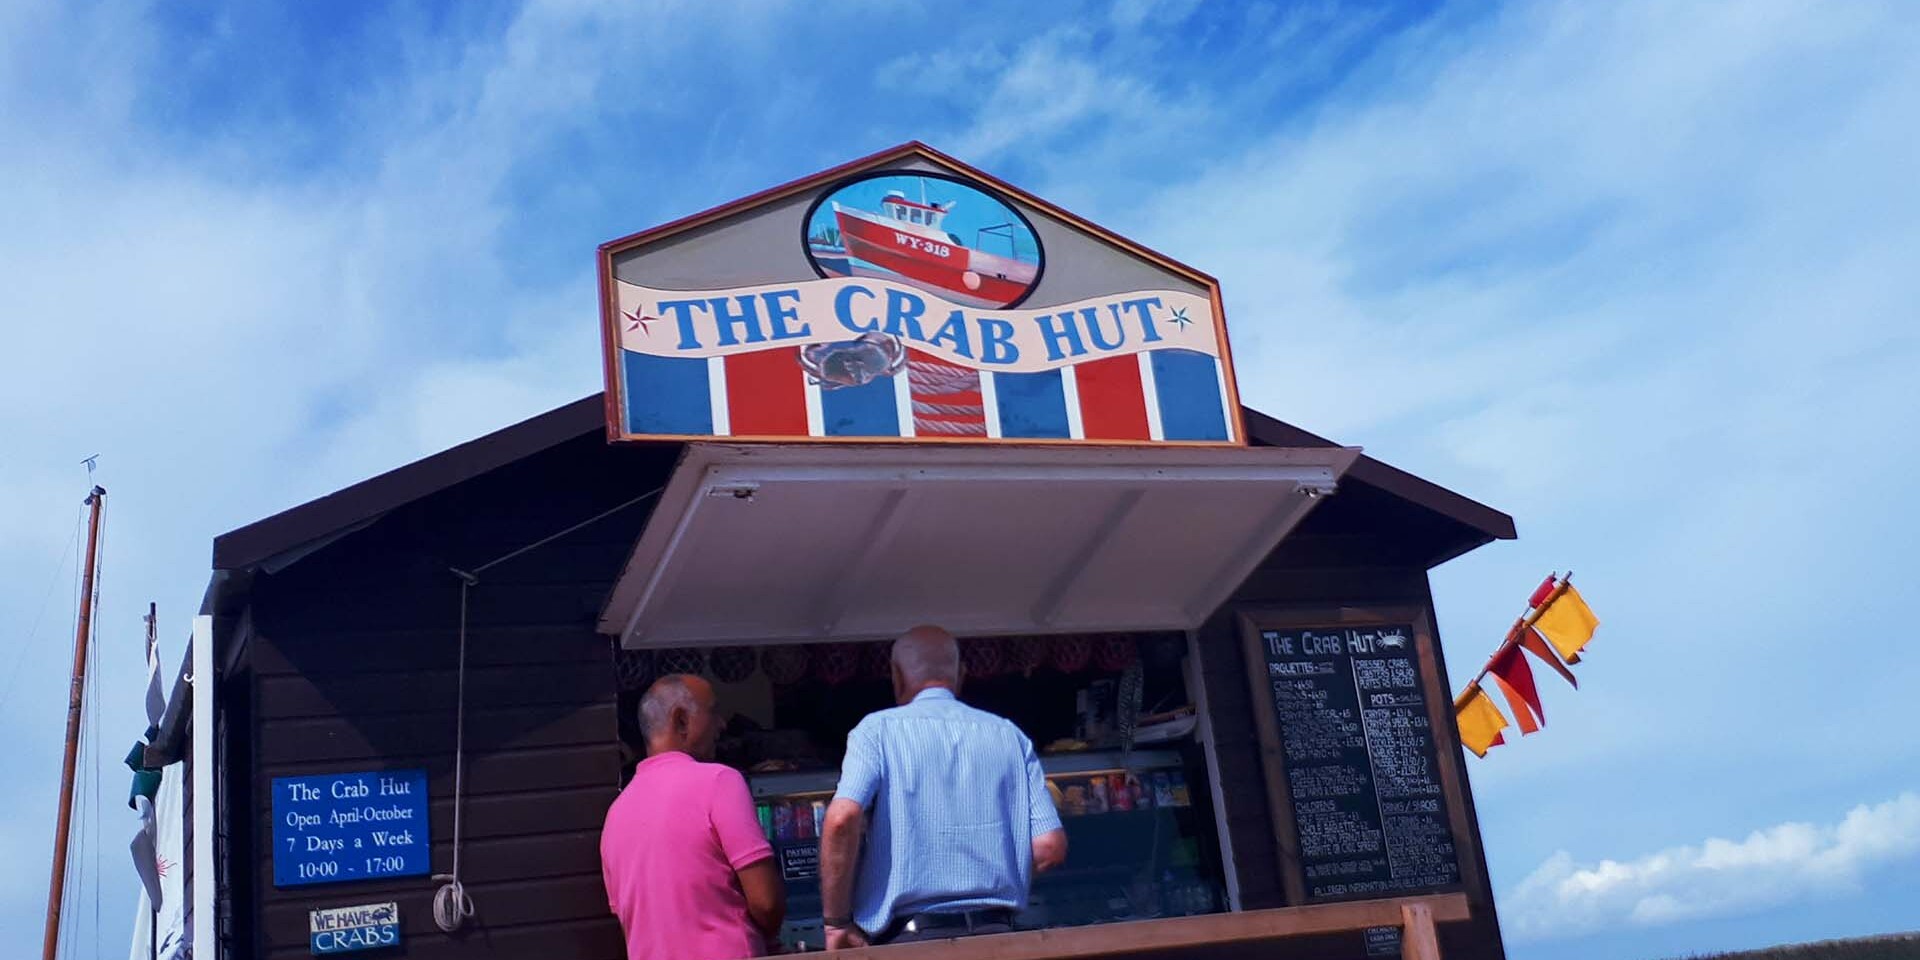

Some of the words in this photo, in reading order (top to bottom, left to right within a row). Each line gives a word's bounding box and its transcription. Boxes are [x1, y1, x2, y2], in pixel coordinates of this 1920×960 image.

[895, 232, 950, 258] WY-318
[658, 289, 811, 349] THE
[834, 285, 1020, 365] CRAB
[1034, 297, 1166, 362] HUT
[1263, 631, 1294, 655] THE
[1302, 631, 1342, 655] CRAB
[1345, 629, 1375, 653] HUT
[1269, 661, 1314, 674] BAGUETTES
[1370, 693, 1396, 705] POTS
[288, 783, 321, 801] The
[331, 780, 369, 798] Crab
[380, 777, 411, 796] Hut
[286, 812, 321, 831] Open
[328, 804, 413, 828] April-October
[286, 837, 296, 852] 7
[307, 835, 344, 854] Days
[354, 838, 362, 848] a
[372, 830, 414, 846] Week
[786, 847, 818, 858] PAYMEN
[365, 856, 404, 873] 17:00
[315, 914, 335, 930] WE
[336, 911, 371, 928] HAVE
[316, 925, 394, 950] CRABS
